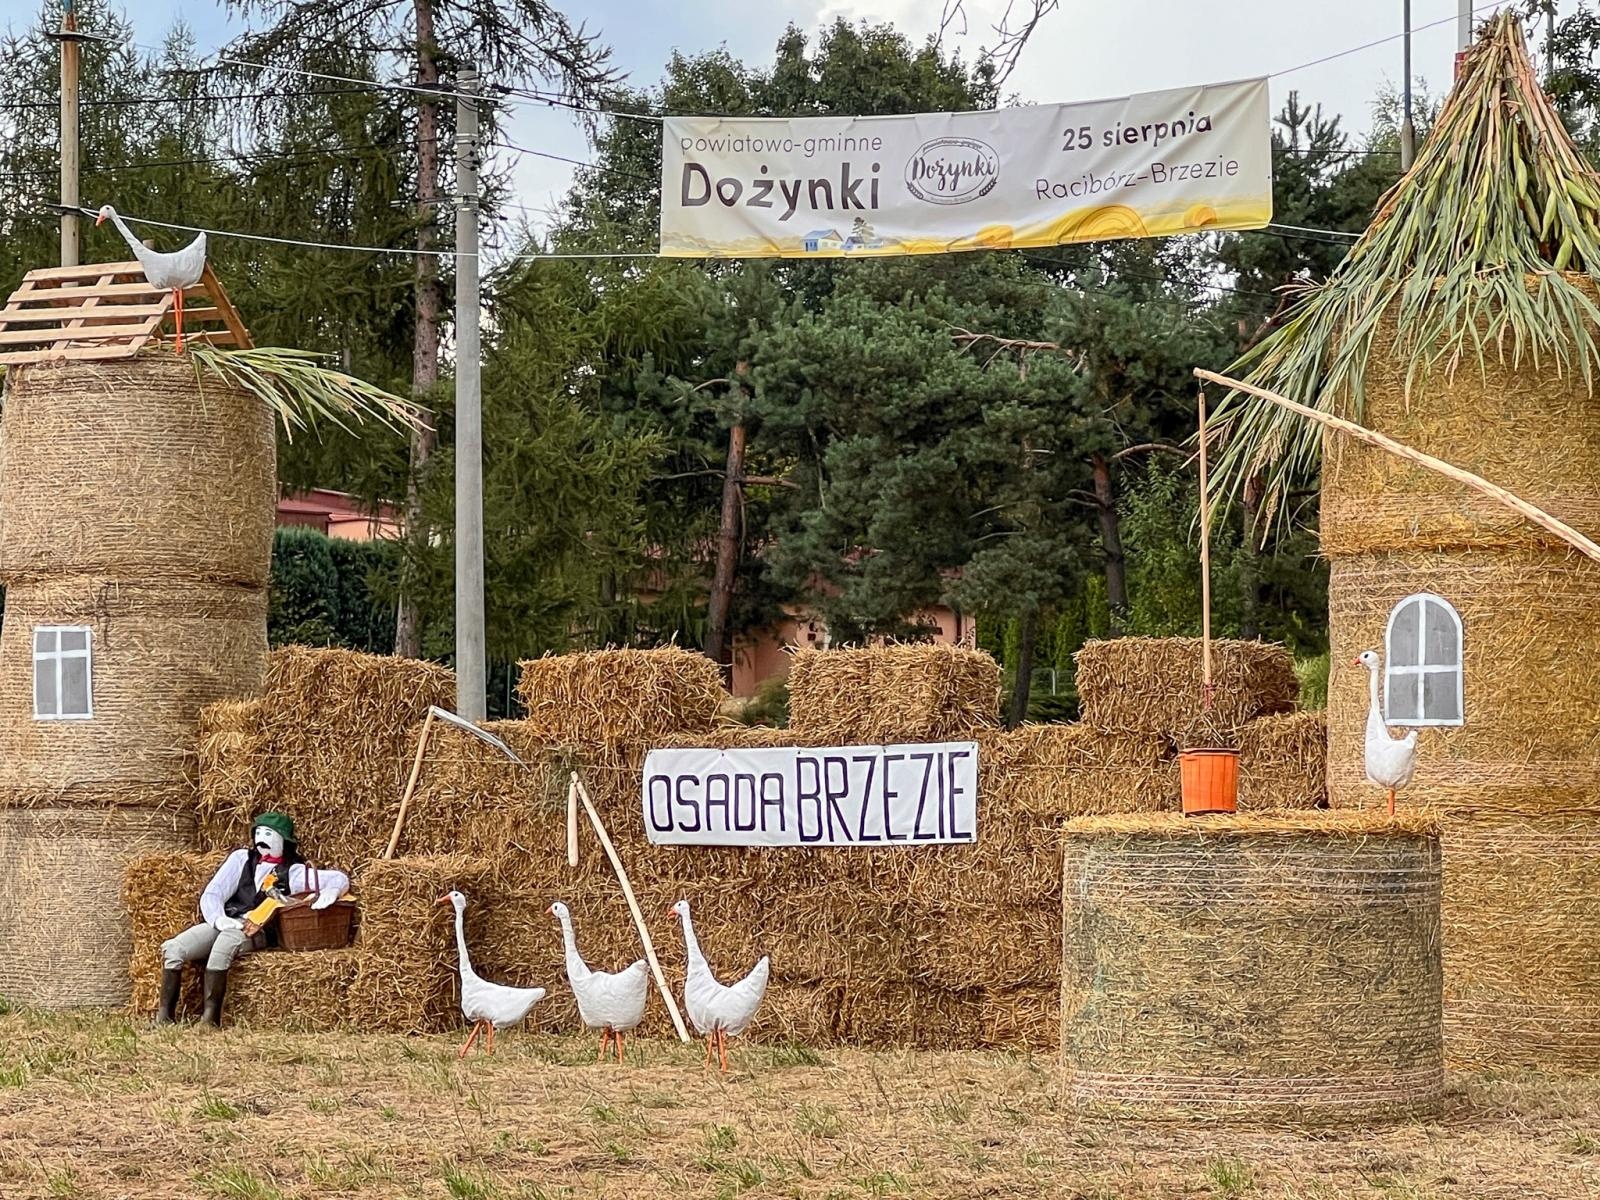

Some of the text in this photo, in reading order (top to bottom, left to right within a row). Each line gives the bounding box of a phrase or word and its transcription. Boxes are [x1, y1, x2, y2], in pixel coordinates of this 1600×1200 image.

[681, 134, 882, 159] powiatowo-gminne
[1062, 111, 1213, 152] 25 sierpnia
[682, 162, 881, 221] Dożynki
[912, 155, 995, 191] Dożynki
[1036, 155, 1239, 201] Racibórz-Brzezie
[649, 751, 973, 843] OSADA BRZEZIE
